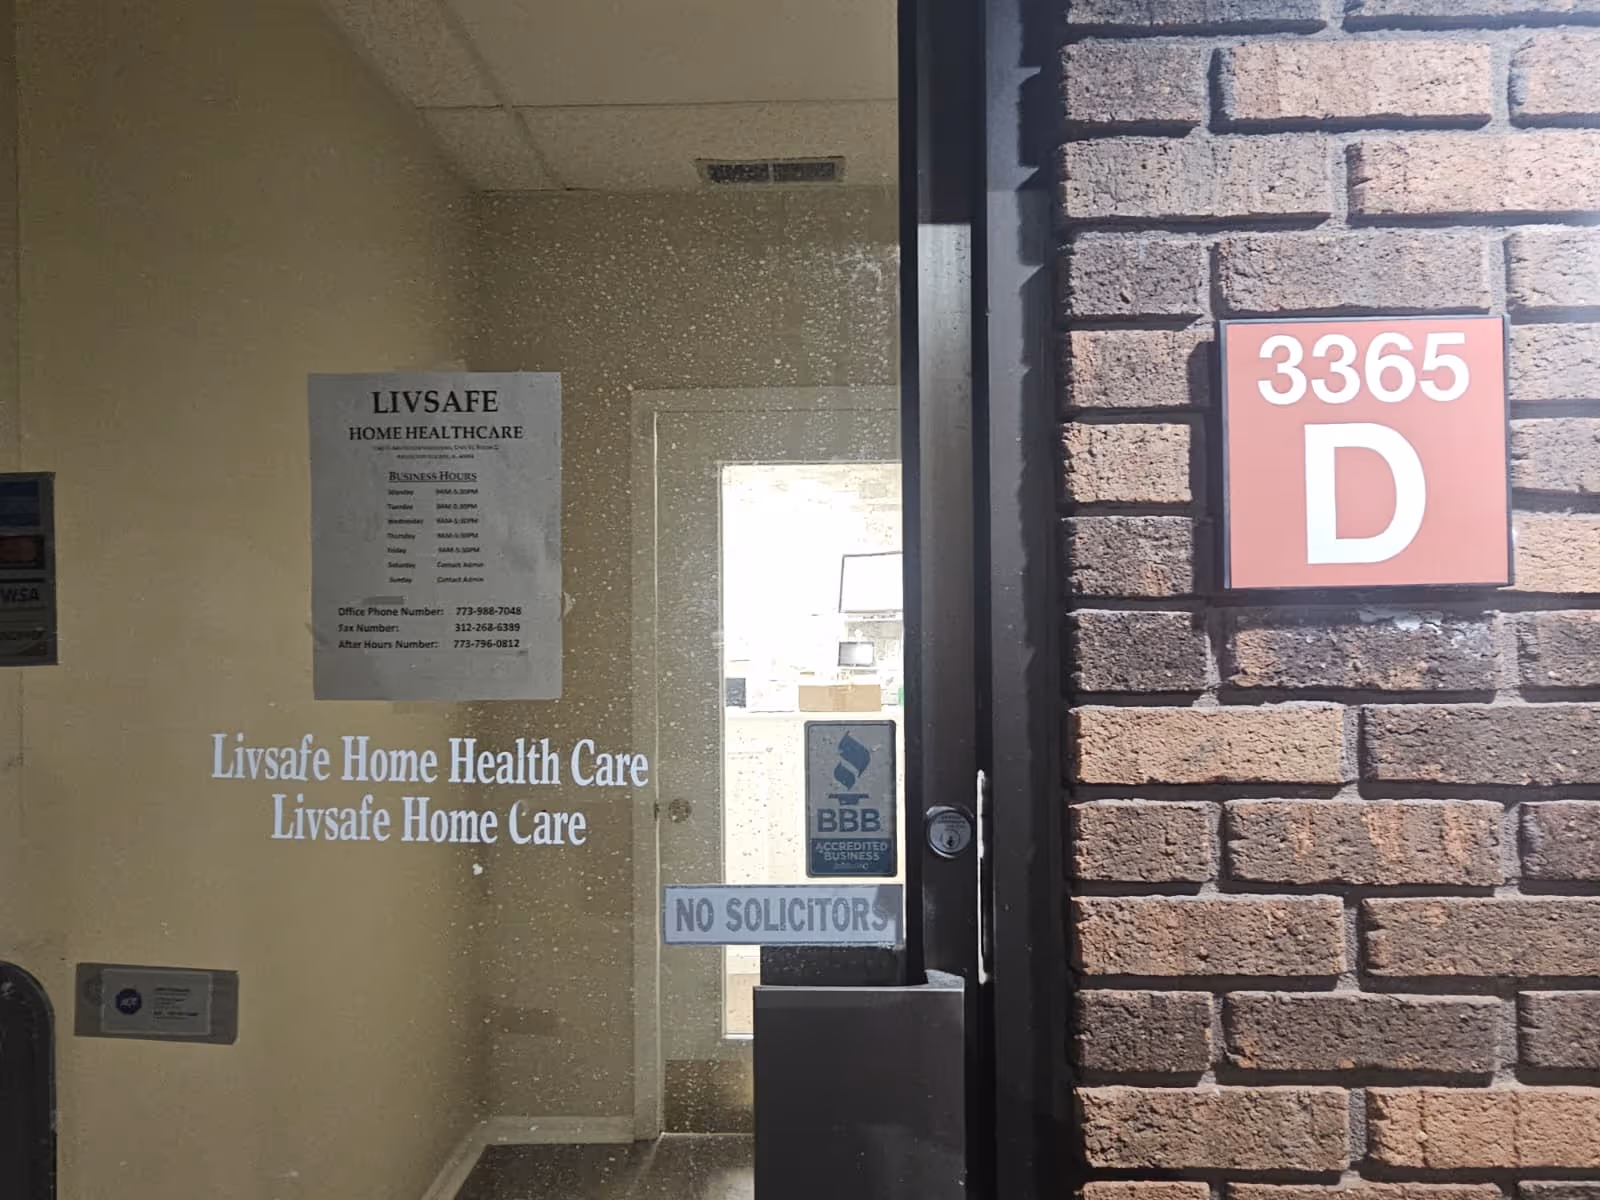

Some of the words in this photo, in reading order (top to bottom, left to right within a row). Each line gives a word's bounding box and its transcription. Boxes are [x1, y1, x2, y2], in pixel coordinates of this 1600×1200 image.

[1257, 332, 1470, 405] 3365
[371, 390, 498, 414] LIVSAFE
[350, 426, 402, 441] HOME
[405, 425, 524, 440] HEALTHCARE
[1304, 422, 1426, 565] D
[338, 607, 365, 616] Office
[368, 607, 398, 616] Phone
[401, 607, 444, 616] Number:
[338, 624, 354, 632] Fax
[356, 623, 399, 632] Number:
[338, 640, 361, 649] After
[364, 640, 392, 649] Hours
[395, 640, 439, 649] Number:
[211, 733, 331, 781] Livsafe
[340, 735, 439, 783] Home
[448, 737, 561, 785] Health
[570, 738, 649, 788] Care
[271, 793, 391, 841] Livsafe
[401, 796, 499, 843] Home
[508, 800, 588, 846] Care
[816, 808, 881, 833] BBB
[815, 841, 888, 851] ACCREDITED
[823, 851, 881, 861] BUSINESS
[675, 897, 715, 932] NO
